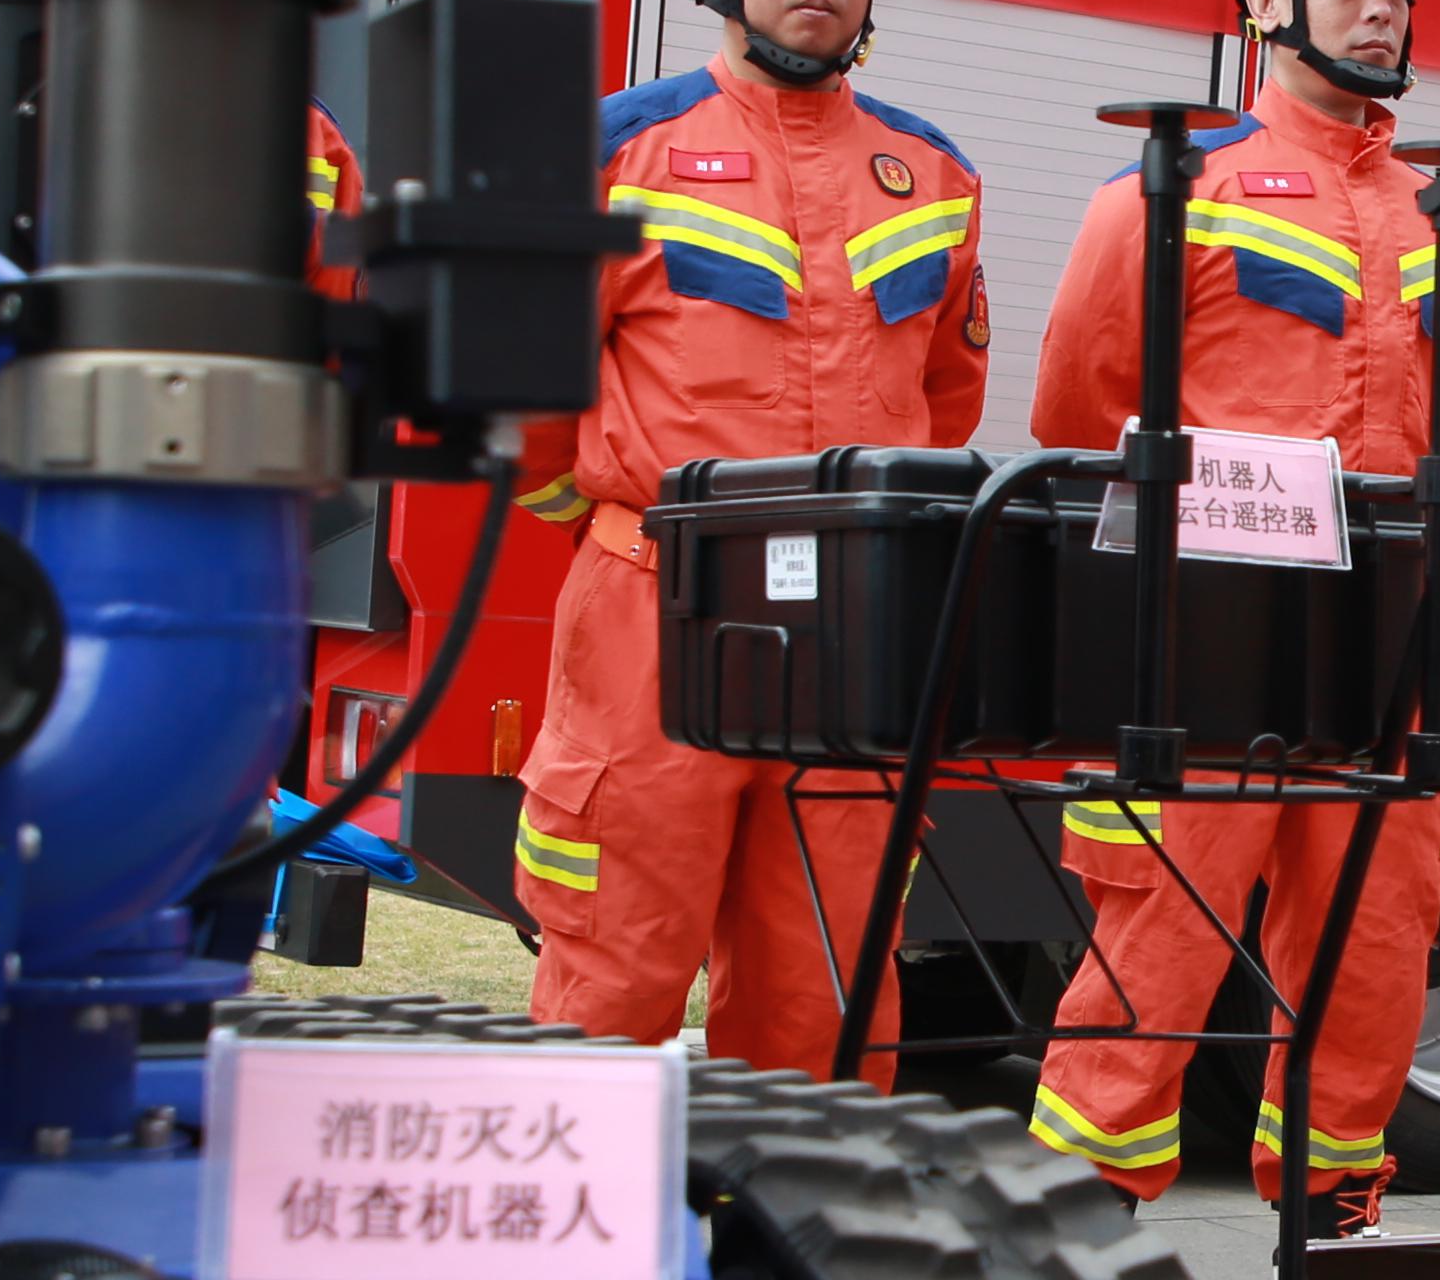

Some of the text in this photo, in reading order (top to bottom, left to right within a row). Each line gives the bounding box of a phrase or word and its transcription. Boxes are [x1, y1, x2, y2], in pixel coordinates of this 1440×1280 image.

[1197, 455, 1287, 495] 机器人
[1178, 495, 1320, 538] 云台遥控器
[316, 1098, 585, 1164] 消防灭火
[277, 1176, 616, 1245] 侦查机器人
